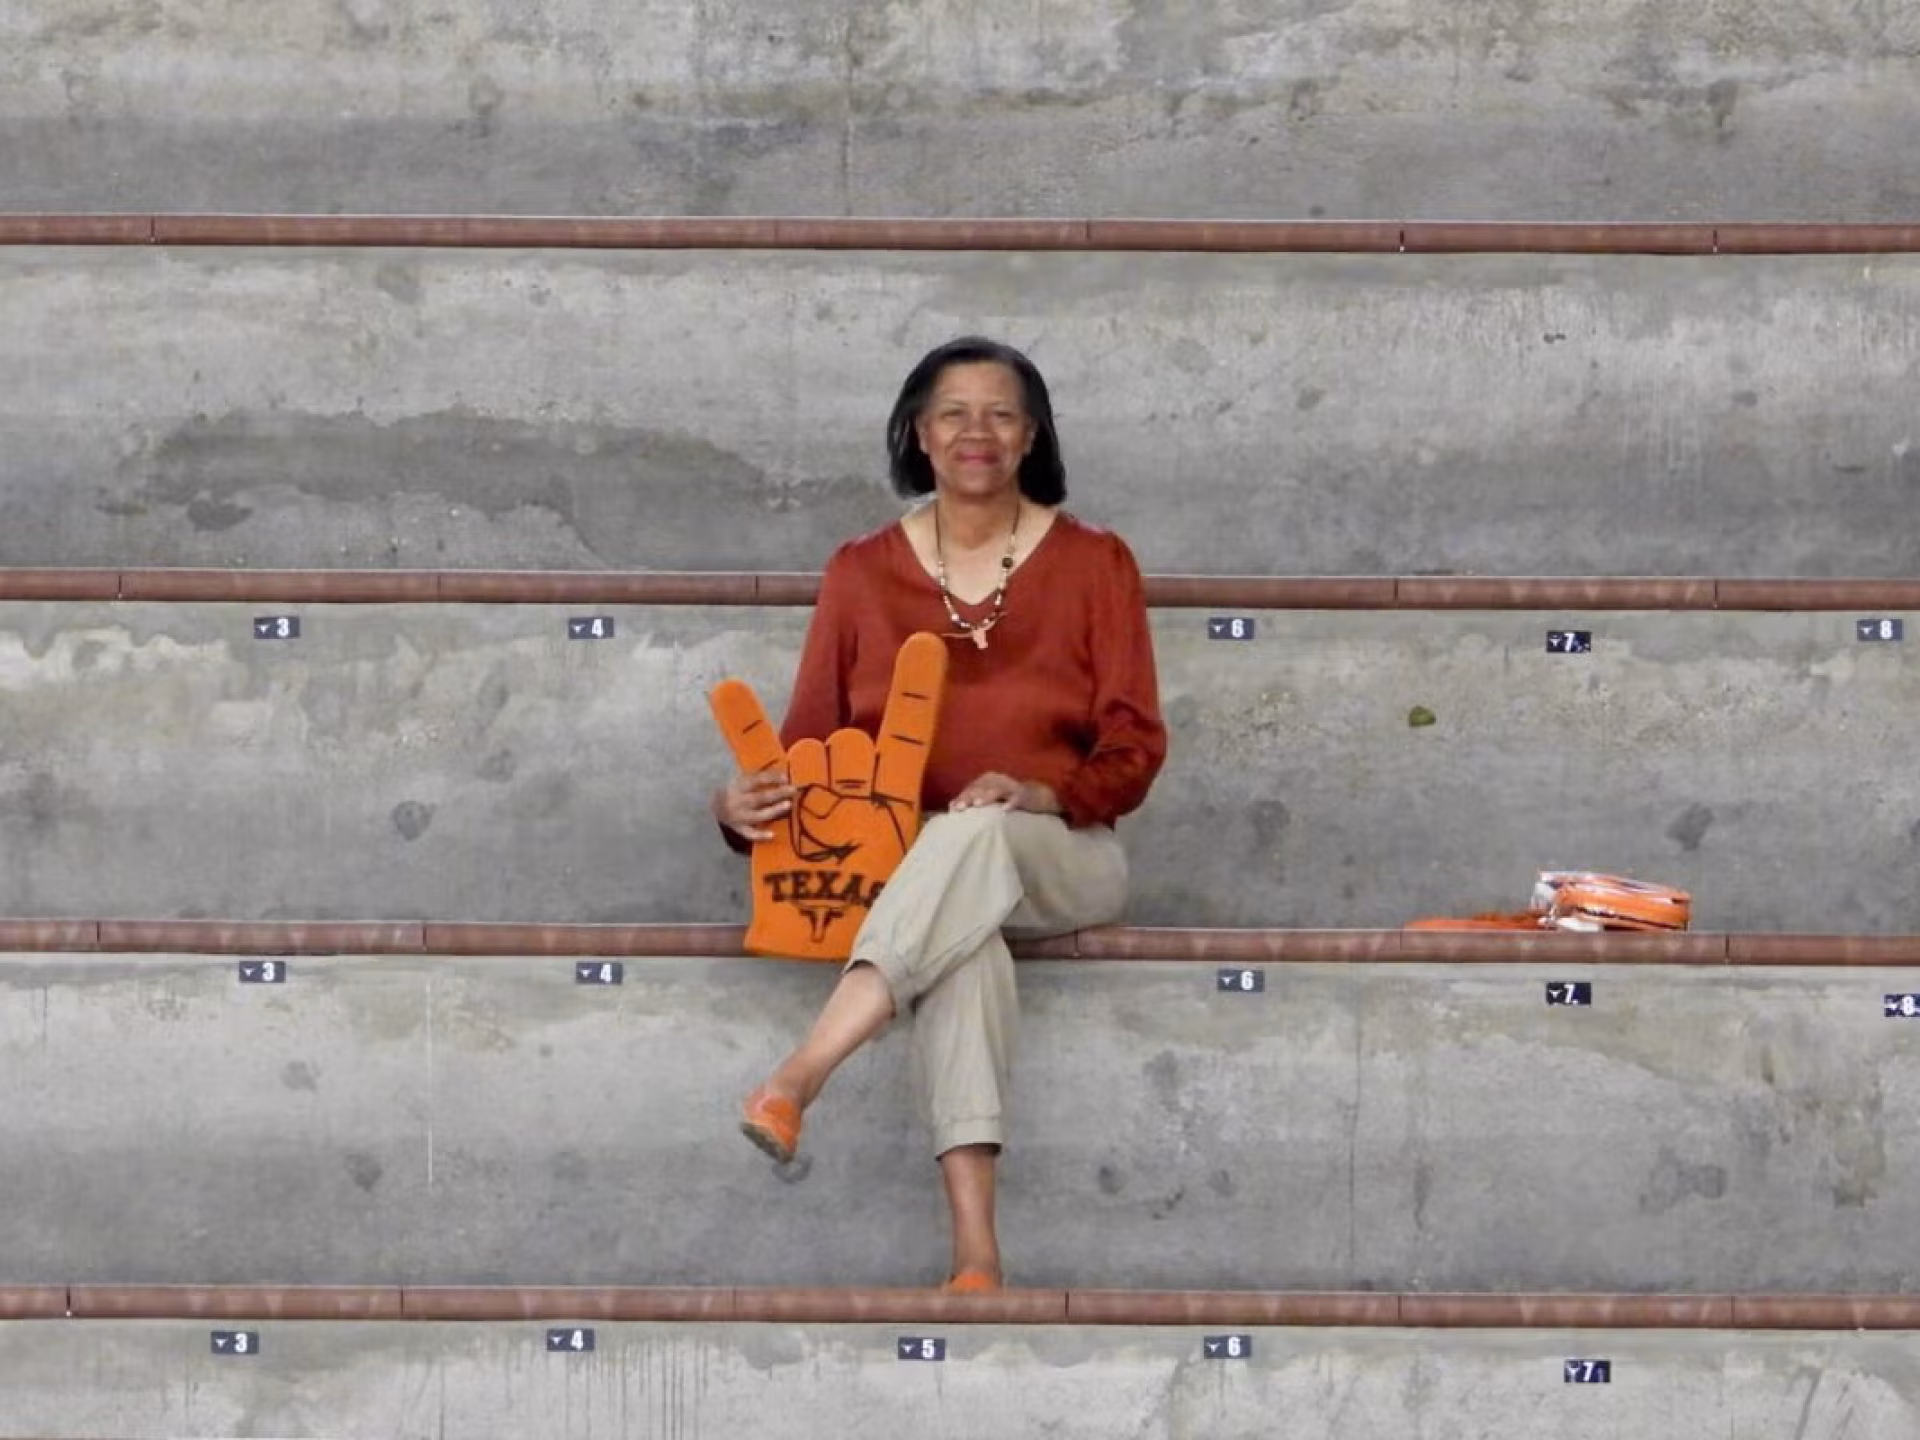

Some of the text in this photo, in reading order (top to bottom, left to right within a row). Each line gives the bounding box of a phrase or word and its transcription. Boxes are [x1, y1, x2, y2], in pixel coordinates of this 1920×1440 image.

[276, 618, 289, 637] 3
[591, 618, 604, 637] 4
[1231, 618, 1244, 638] 6
[1879, 620, 1892, 639] 8
[262, 963, 275, 982] 3
[599, 963, 612, 982] 4
[1240, 970, 1253, 990] 6
[235, 1333, 248, 1352] 3
[571, 1330, 584, 1349] 4
[922, 1338, 935, 1357] 5
[1228, 1337, 1241, 1356] 6
[1583, 1361, 1594, 1381] 7
